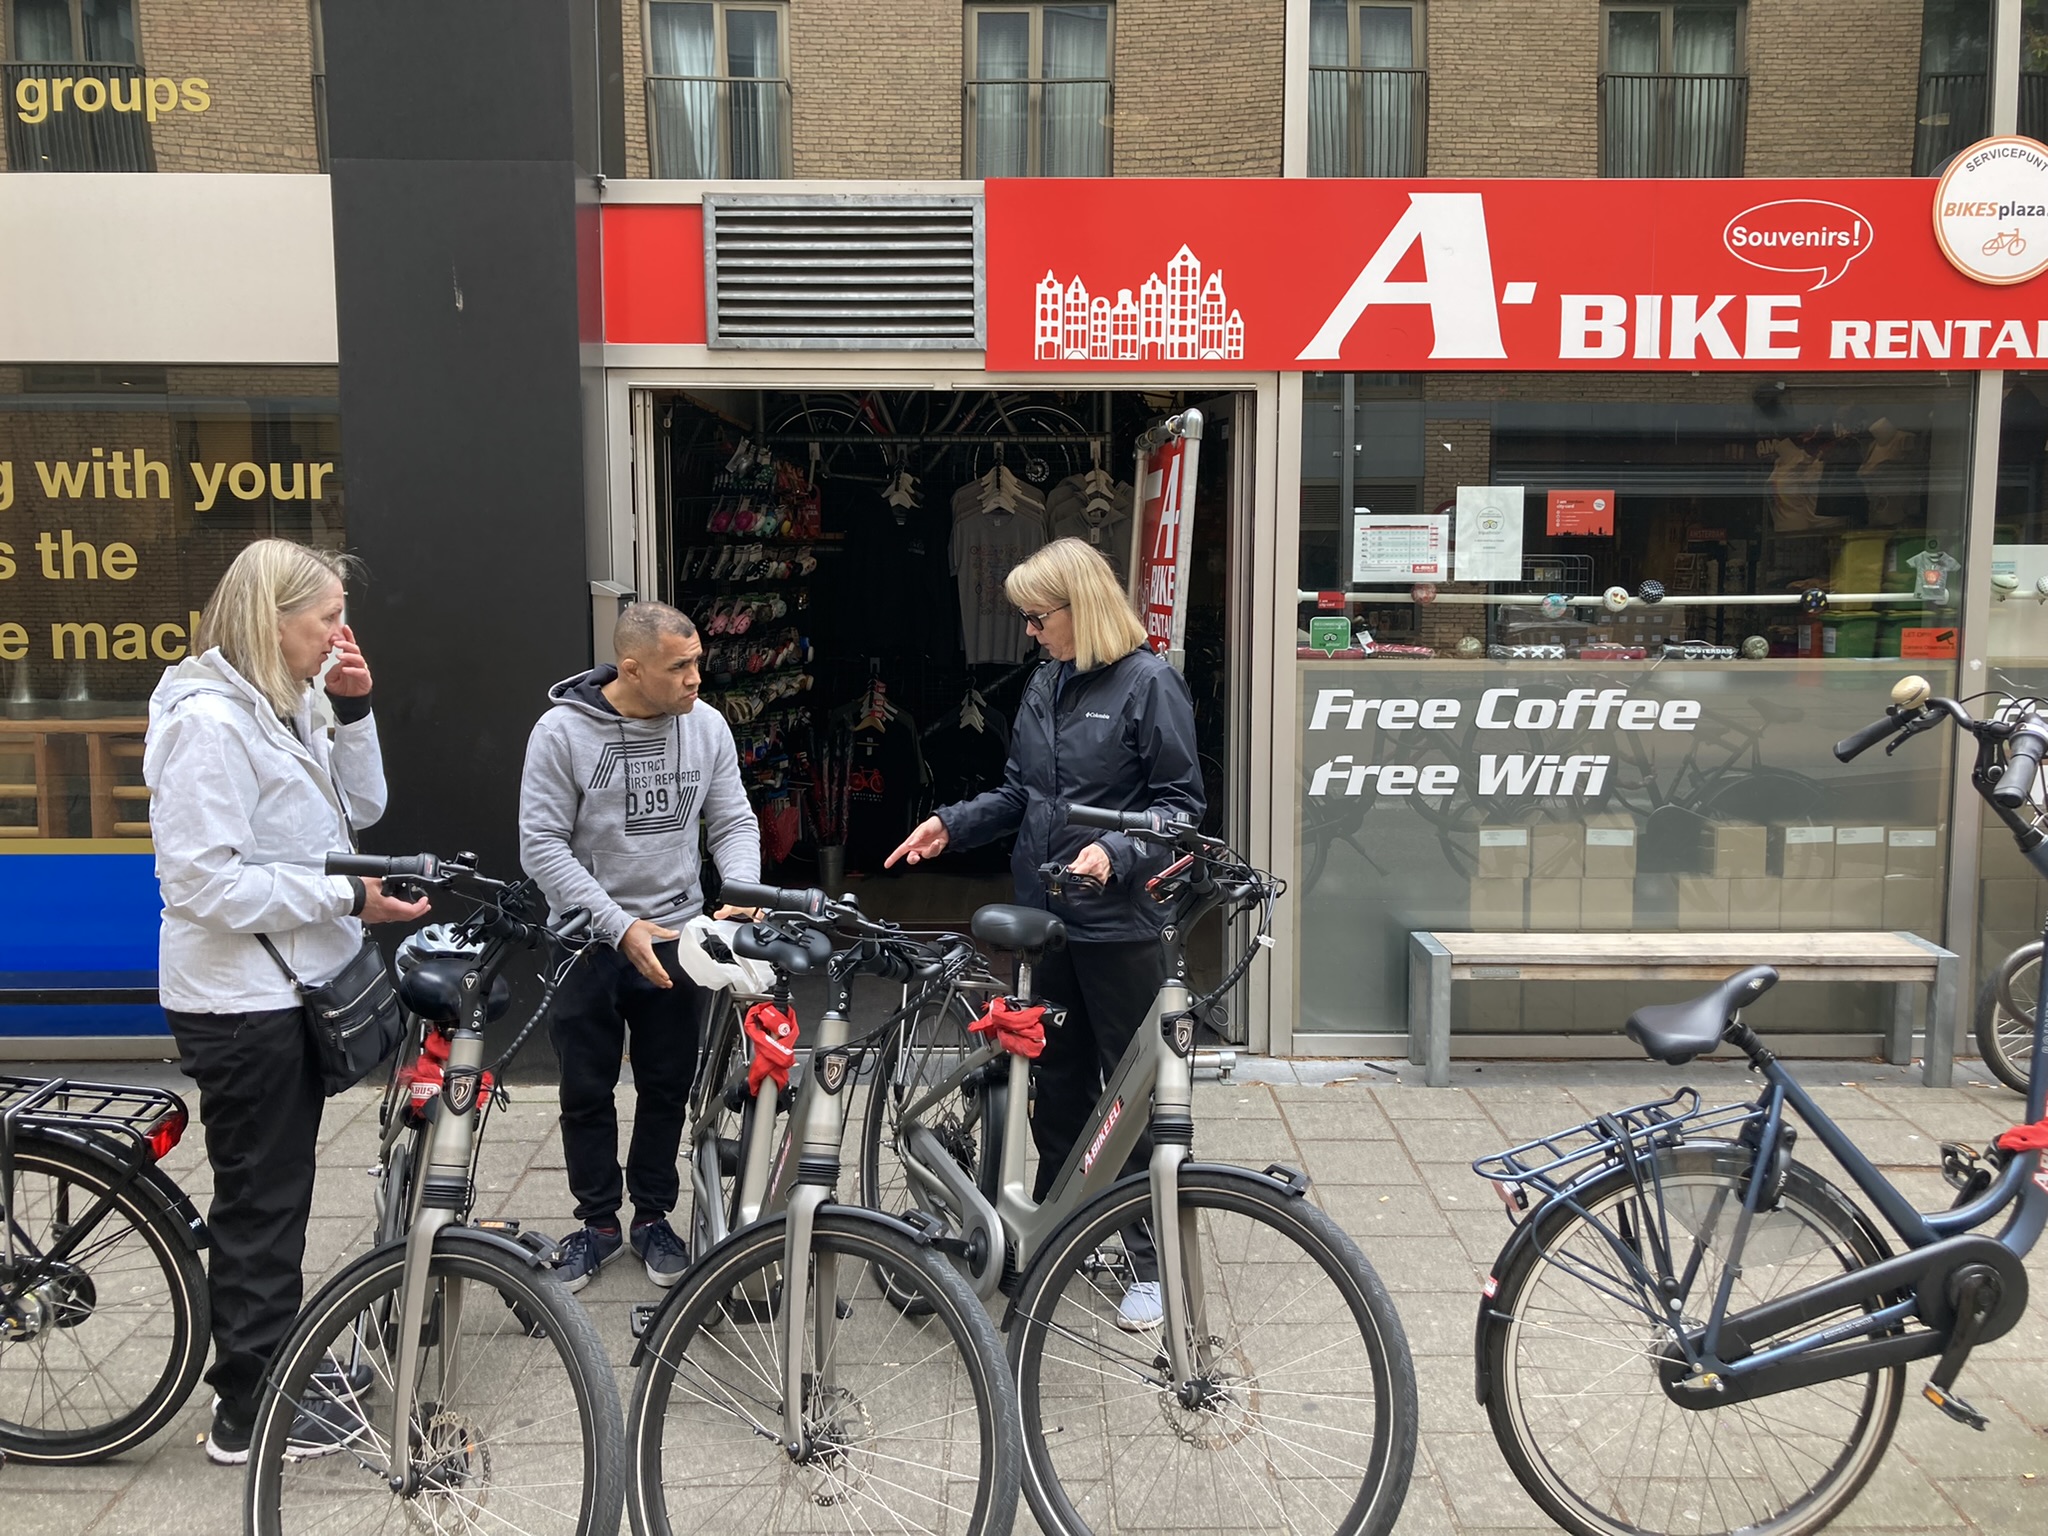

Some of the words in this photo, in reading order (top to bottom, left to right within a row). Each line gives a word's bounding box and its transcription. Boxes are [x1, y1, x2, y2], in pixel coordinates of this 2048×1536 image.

[16, 77, 211, 123] groups
[1966, 147, 2048, 172] SERVICEPUNT
[1731, 220, 1861, 247] Souvenirs!
[1558, 293, 1802, 360] BIKE
[34, 447, 171, 499] with
[190, 462, 334, 511] your
[35, 530, 138, 580] the
[1308, 688, 1462, 730] Free
[1474, 688, 1702, 731] Coffee
[1308, 755, 1461, 796] Free
[1477, 755, 1611, 796] Wifi
